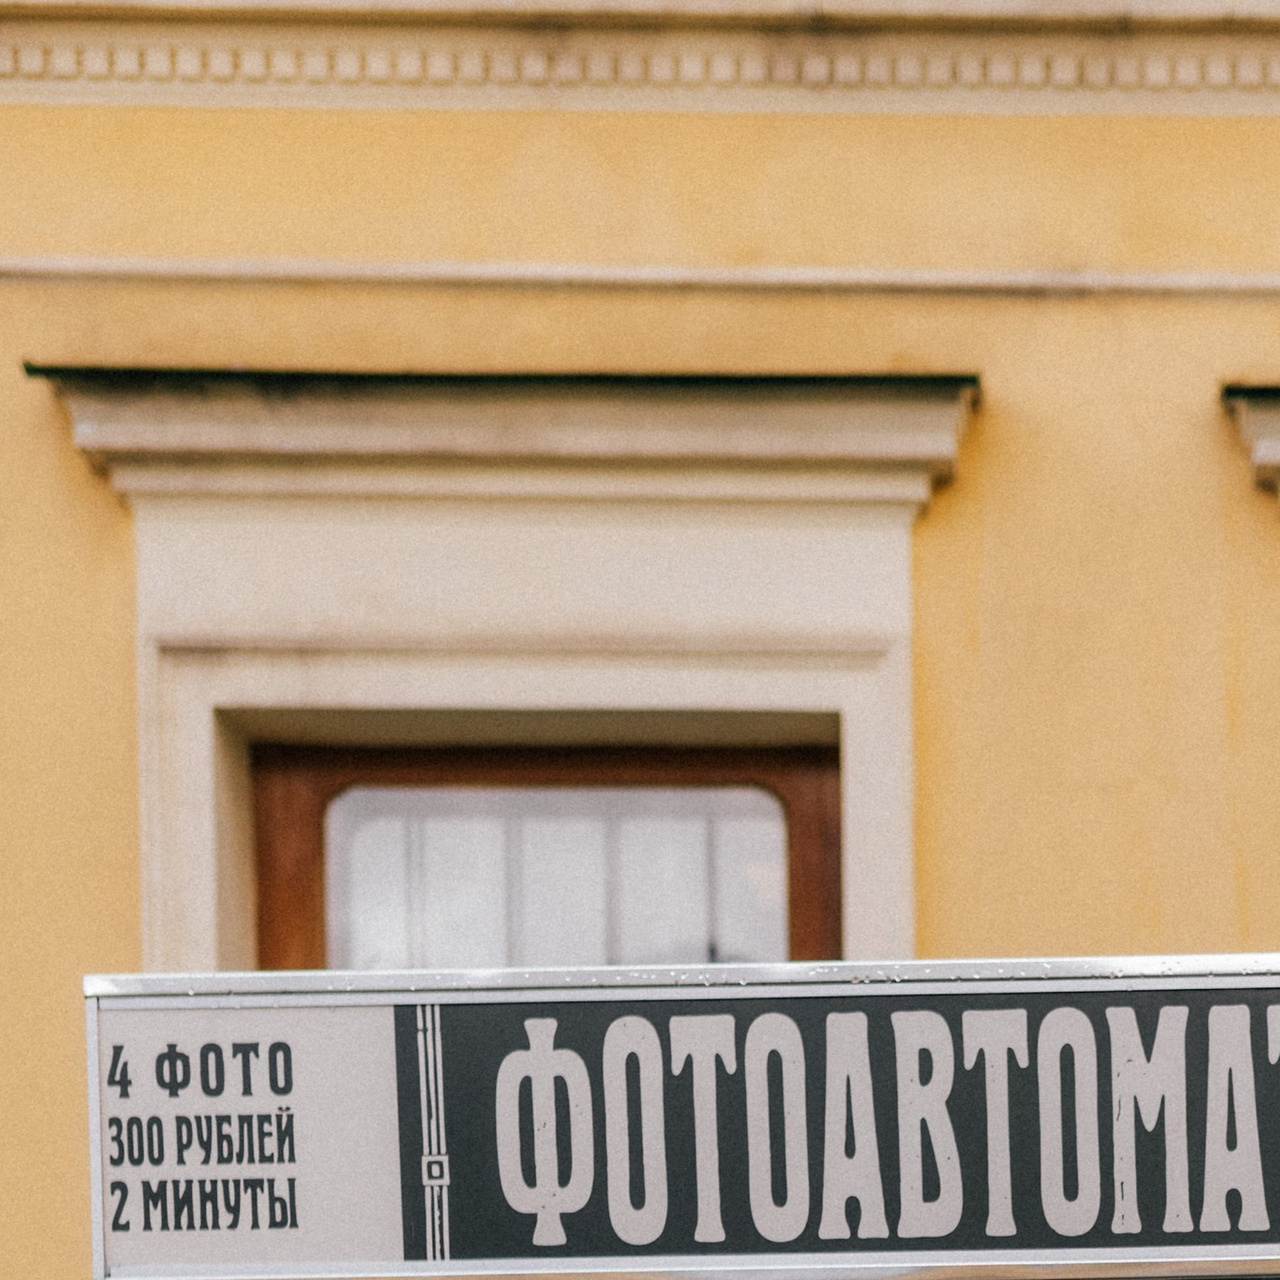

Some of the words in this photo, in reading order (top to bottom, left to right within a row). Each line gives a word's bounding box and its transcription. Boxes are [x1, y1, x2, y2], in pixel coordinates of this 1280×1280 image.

[107, 1045, 132, 1098] 4
[156, 1042, 293, 1098] ФОТО
[108, 1116, 164, 1167] 300
[175, 1106, 296, 1165] РУБЛЕЙ
[110, 1181, 130, 1232] 2
[141, 1178, 299, 1231] МИНУТЫ
